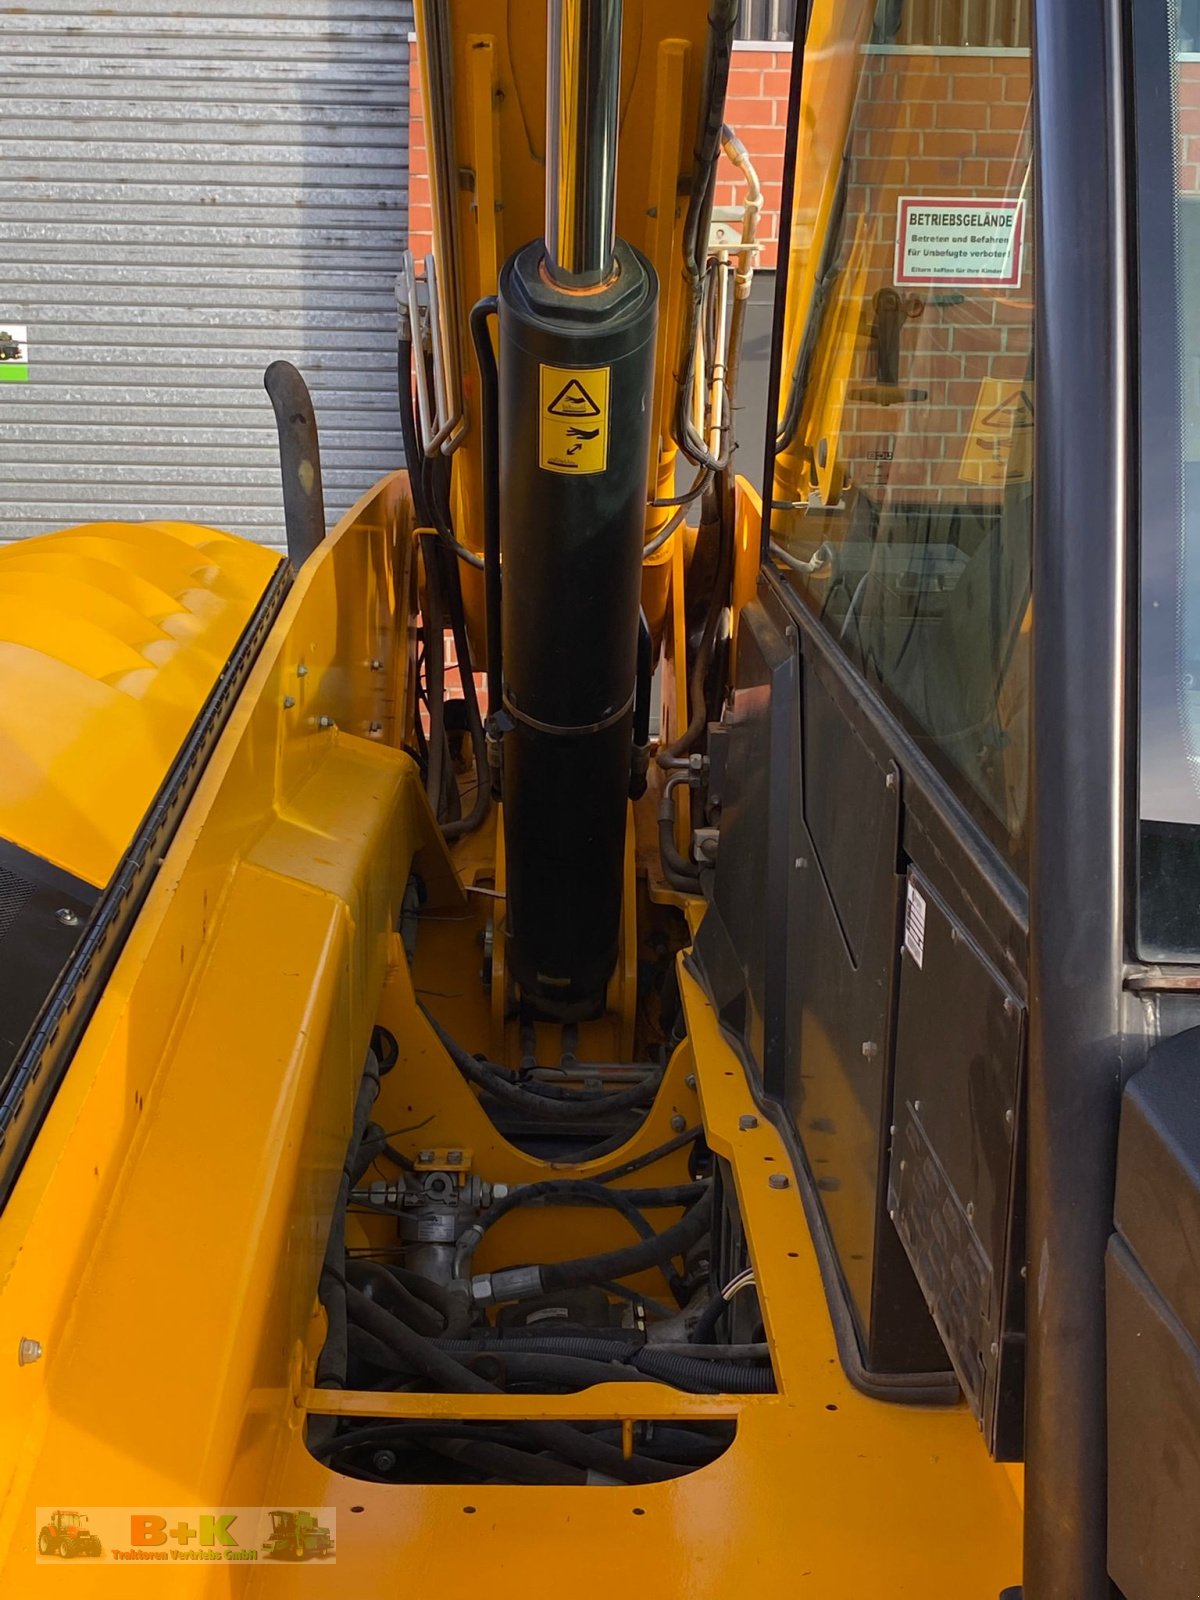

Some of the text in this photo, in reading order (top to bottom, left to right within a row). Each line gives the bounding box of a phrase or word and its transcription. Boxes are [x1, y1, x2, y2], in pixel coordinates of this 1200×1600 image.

[909, 212, 1012, 227] BETRIEBSGELÄNDE
[911, 235, 949, 243] Betreten
[970, 236, 1009, 244] Befahren
[908, 248, 921, 256] für
[923, 249, 968, 258] Unbefugte
